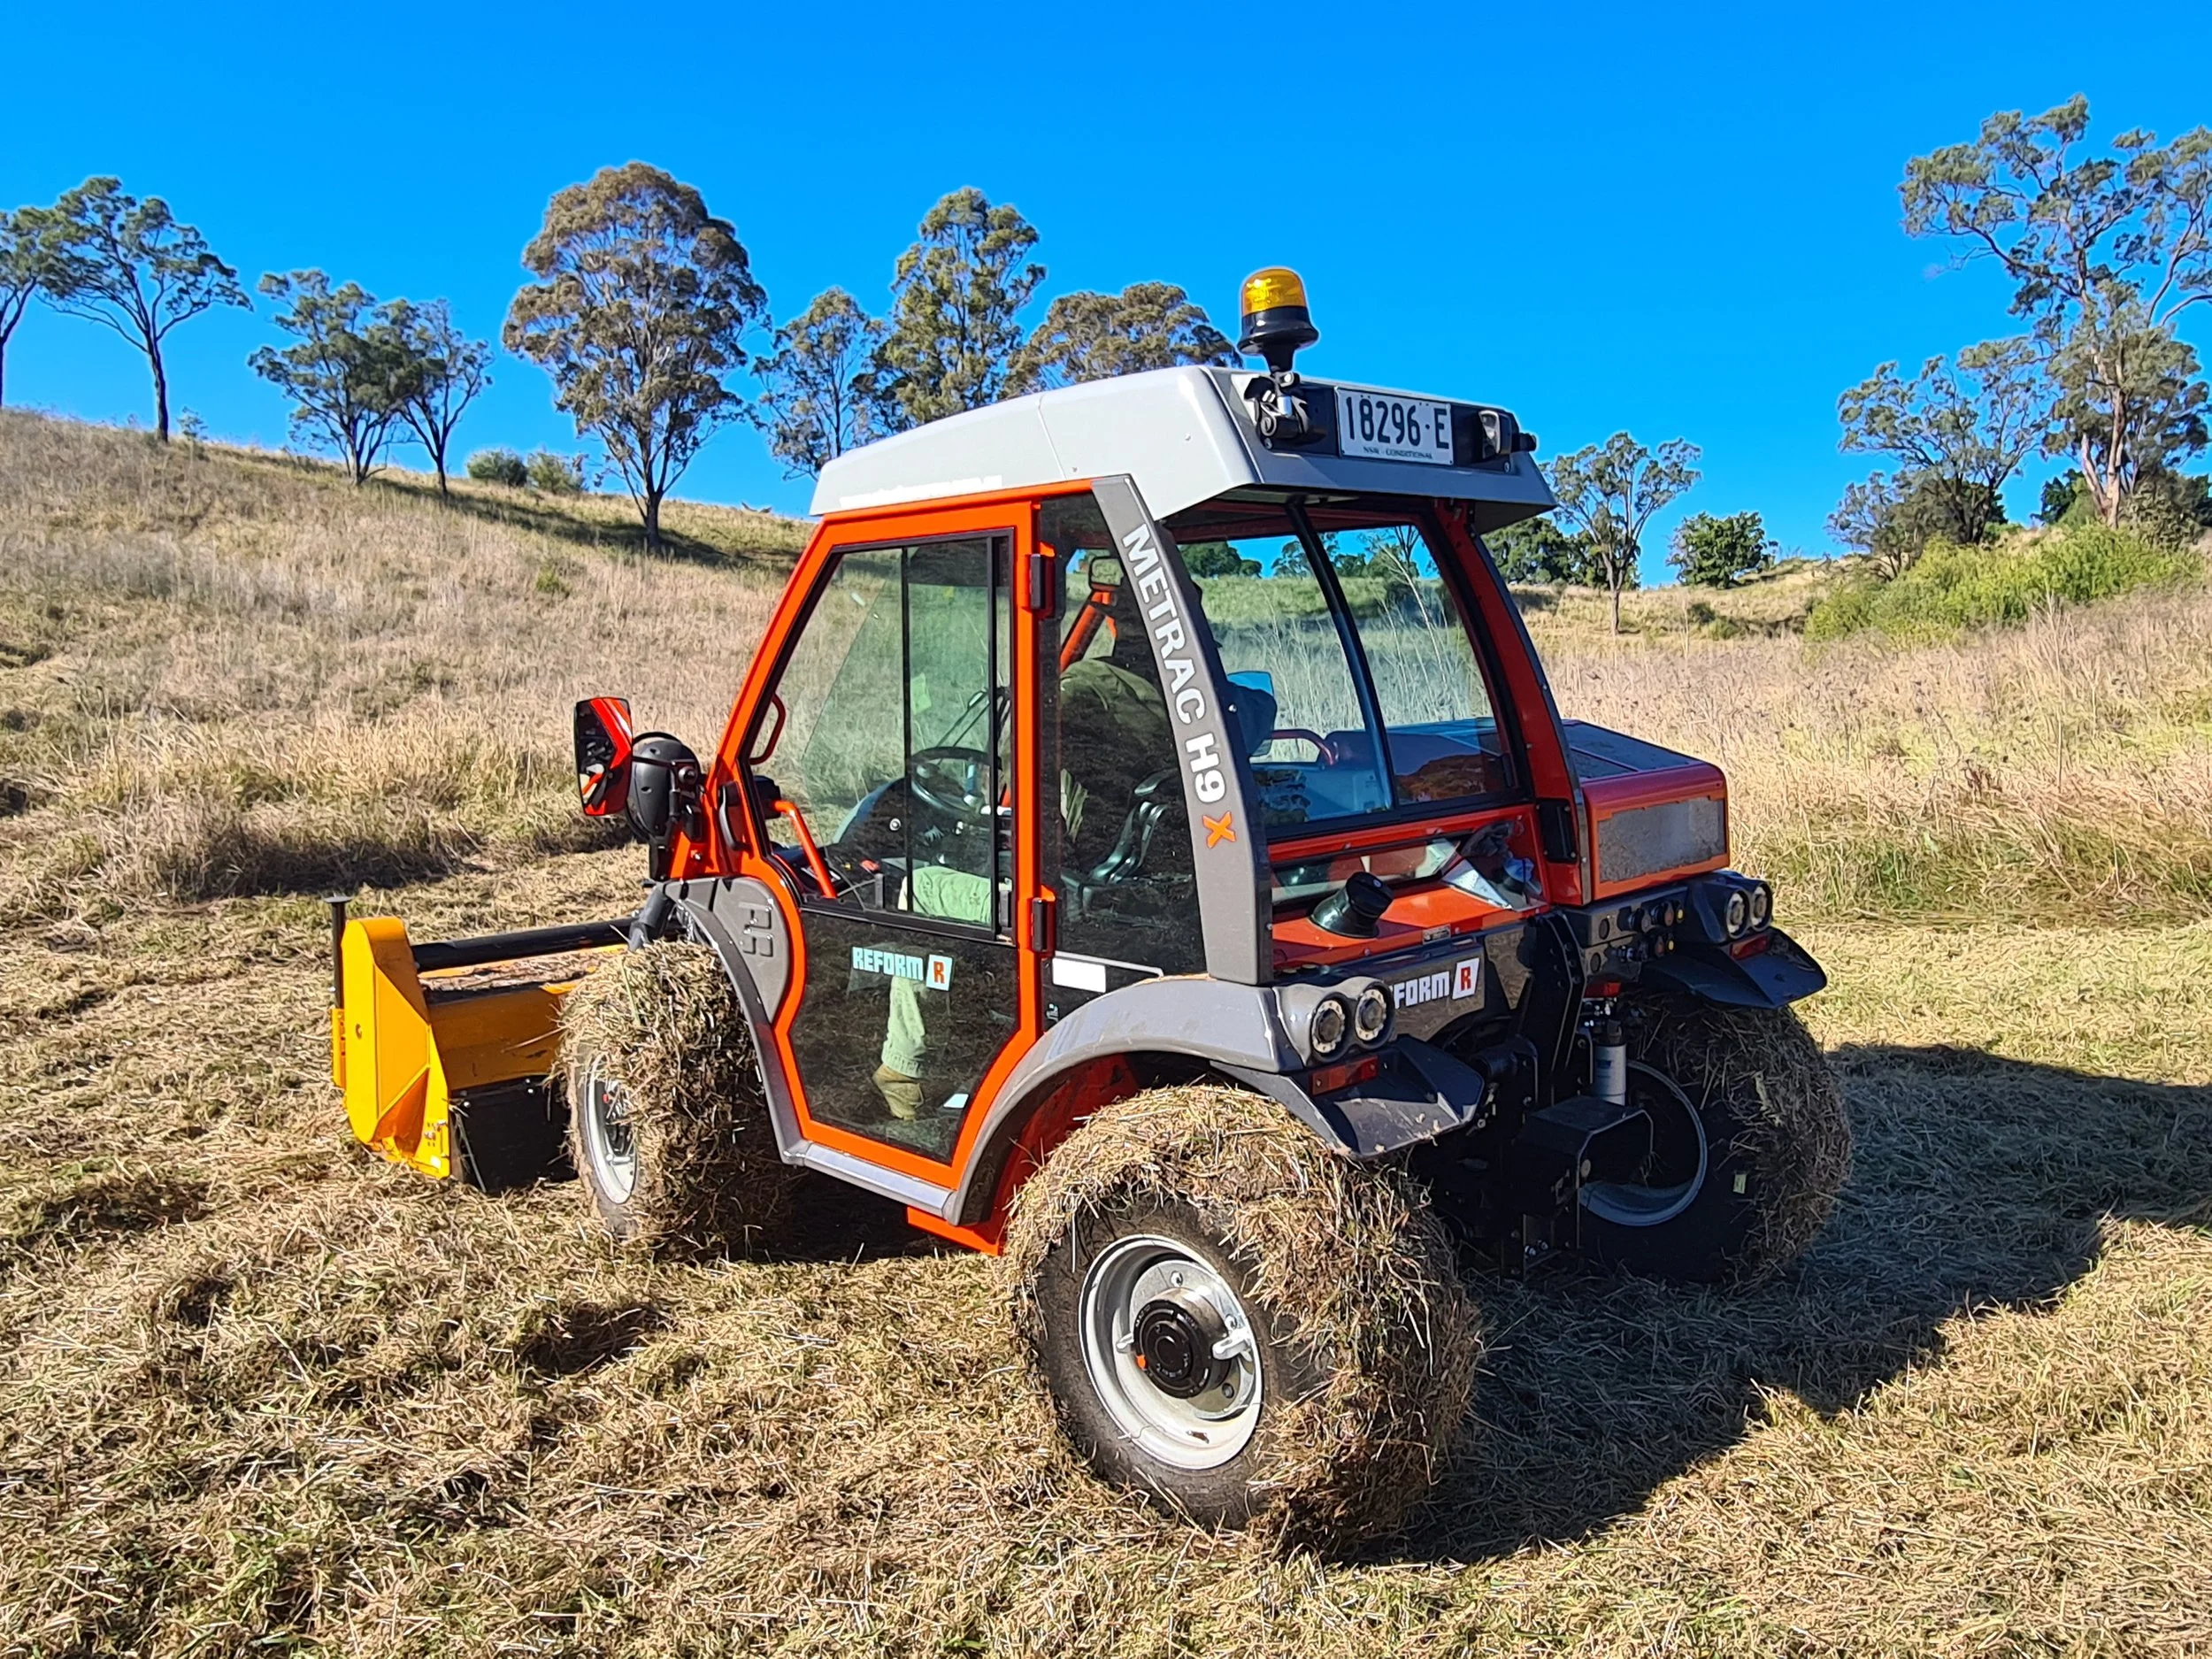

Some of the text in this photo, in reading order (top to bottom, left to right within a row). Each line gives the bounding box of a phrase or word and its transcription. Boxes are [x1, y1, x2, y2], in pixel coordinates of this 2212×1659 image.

[1122, 523, 1237, 849] METRAC H9 X
[852, 946, 924, 981] REFORM
[1389, 971, 1450, 1010] FORM
